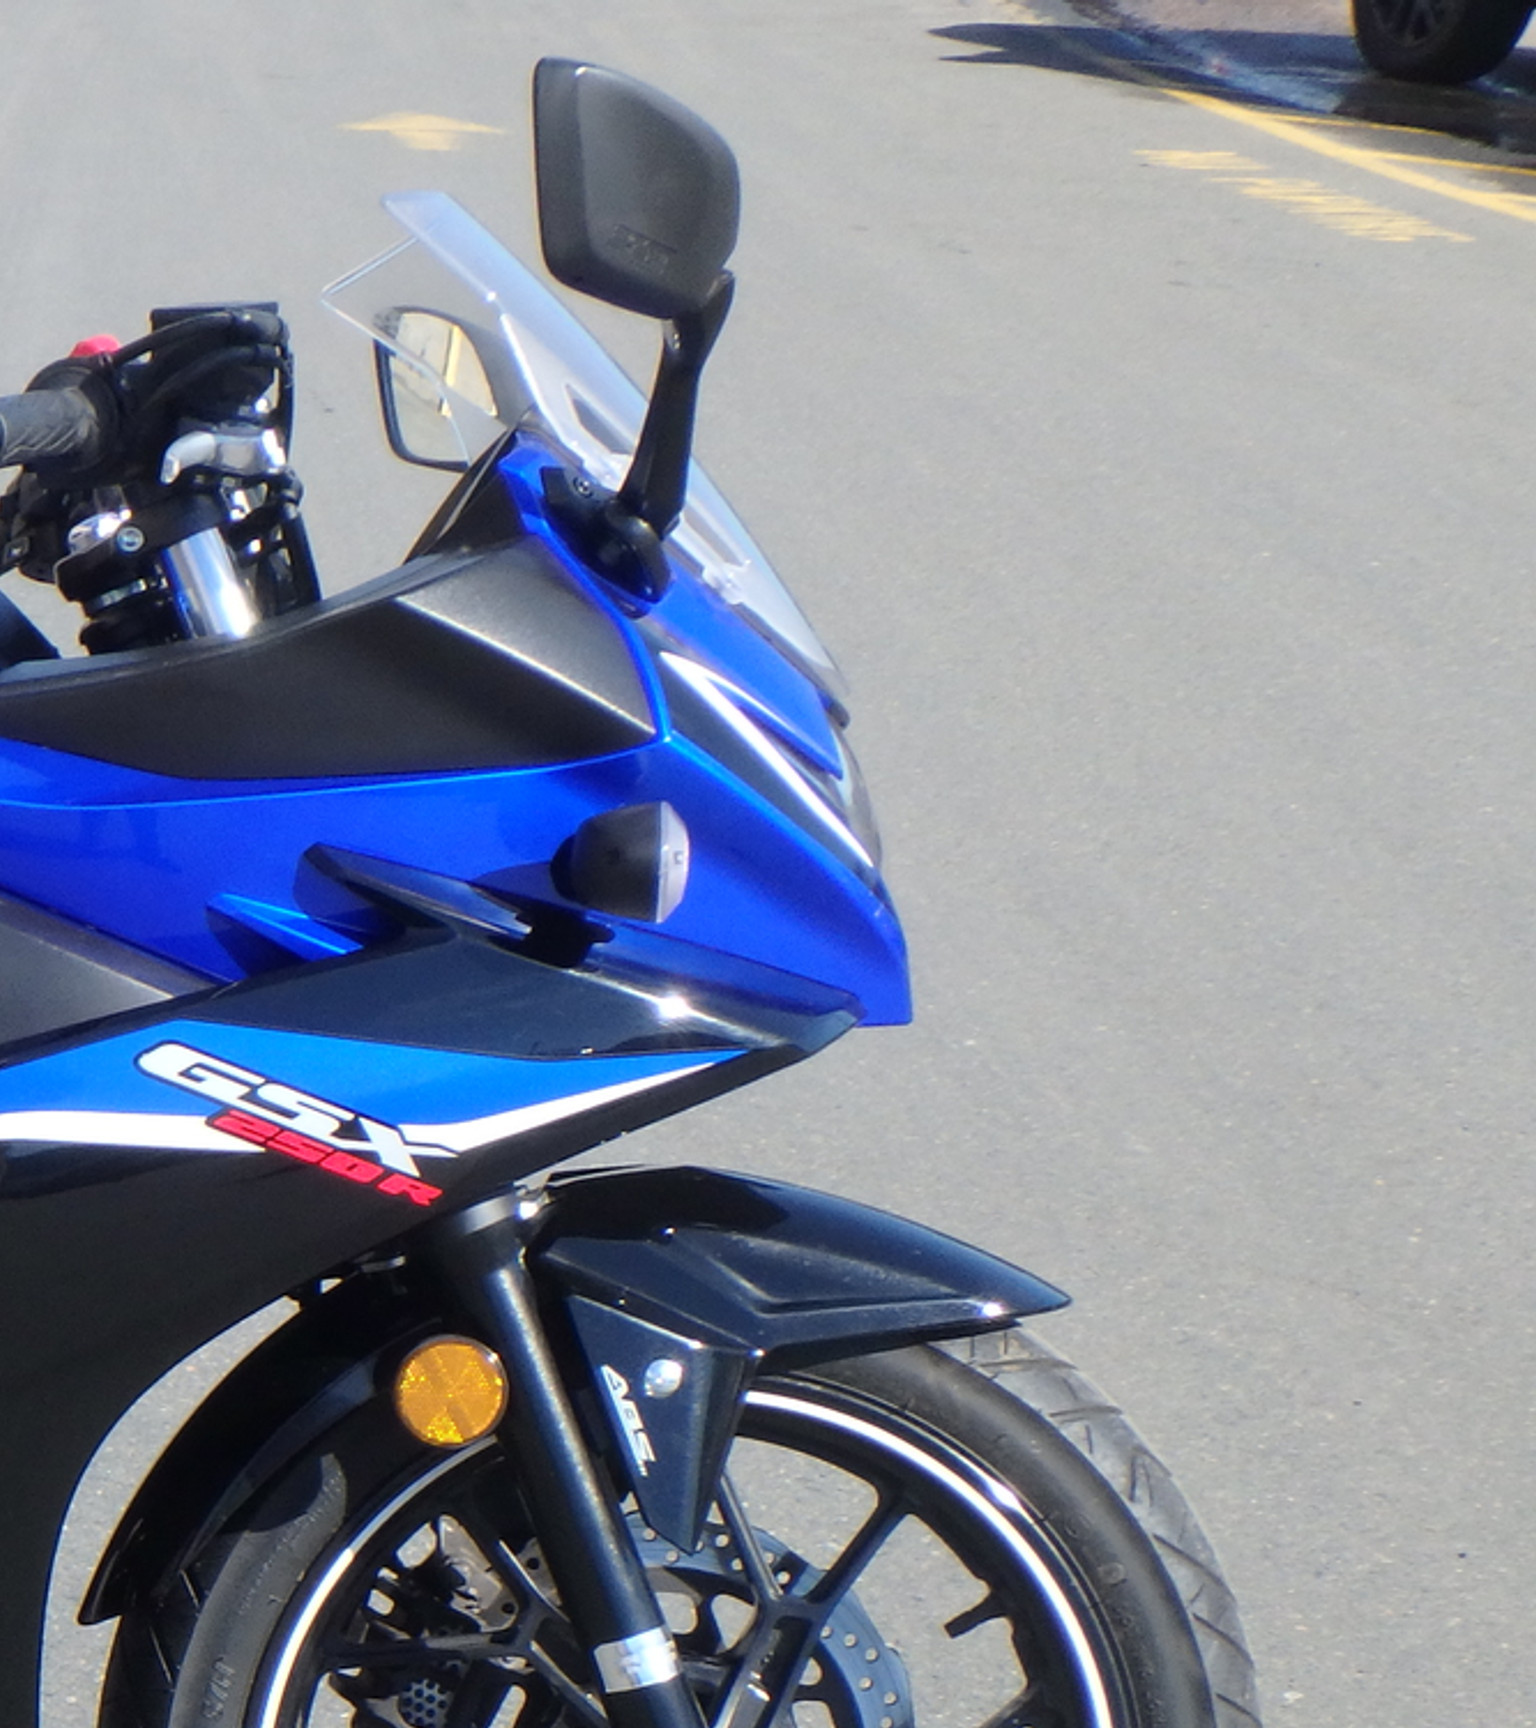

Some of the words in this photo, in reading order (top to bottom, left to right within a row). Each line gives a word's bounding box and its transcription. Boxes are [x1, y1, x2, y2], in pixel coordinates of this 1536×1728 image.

[136, 1042, 457, 1179] GSX
[211, 1110, 443, 1206] 250R
[600, 1364, 656, 1476] ABS
